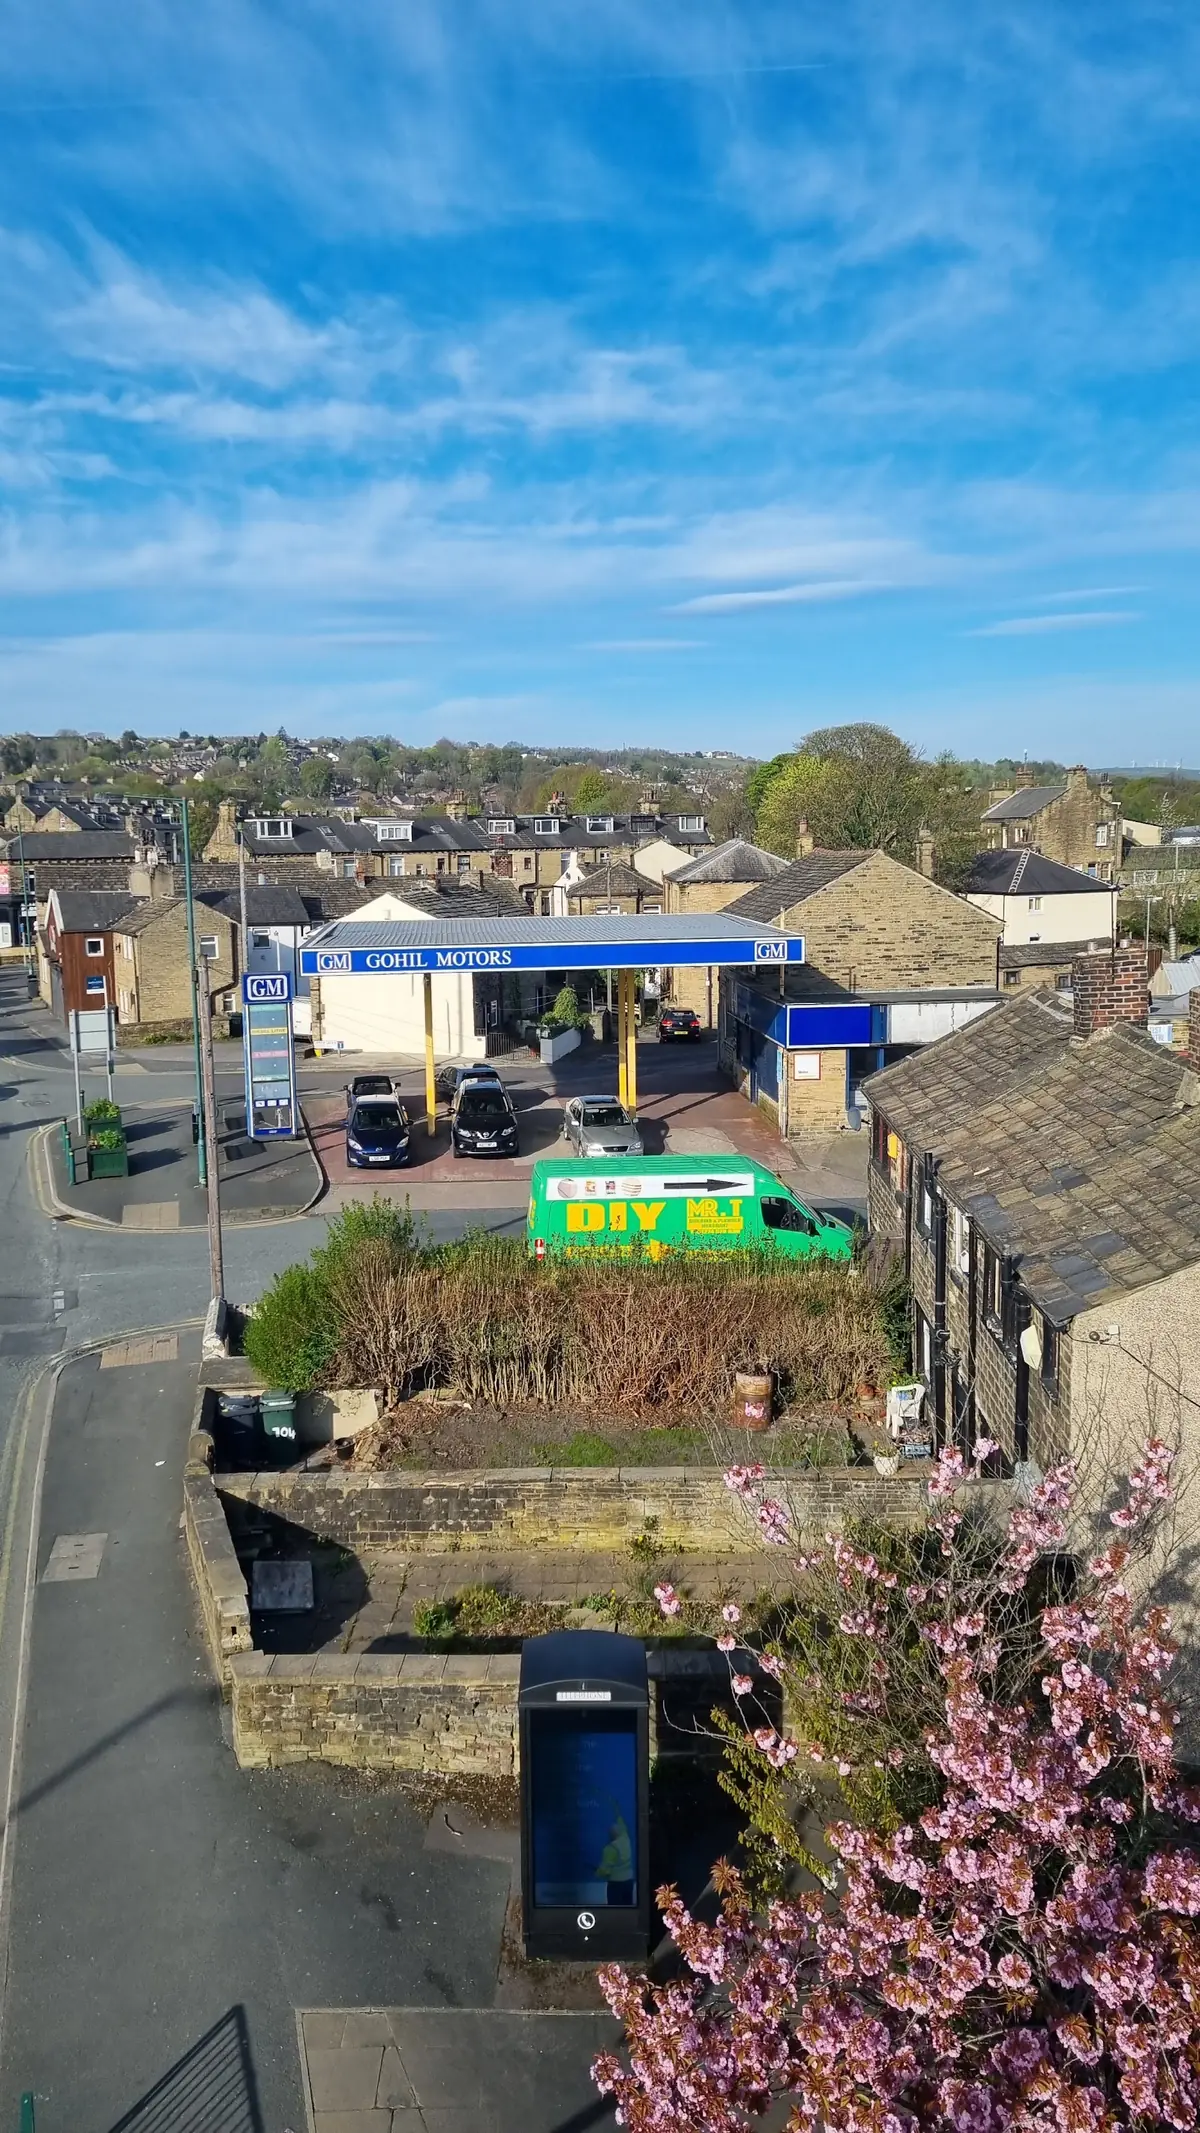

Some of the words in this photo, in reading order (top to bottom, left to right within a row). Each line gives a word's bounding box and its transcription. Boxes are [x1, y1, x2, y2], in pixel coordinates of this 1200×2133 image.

[366, 952, 428, 968] GOHIL
[436, 950, 511, 966] MOTORS
[757, 943, 784, 958] GM
[320, 954, 349, 969] GM
[252, 979, 283, 997] GM
[566, 1202, 666, 1232] DIY
